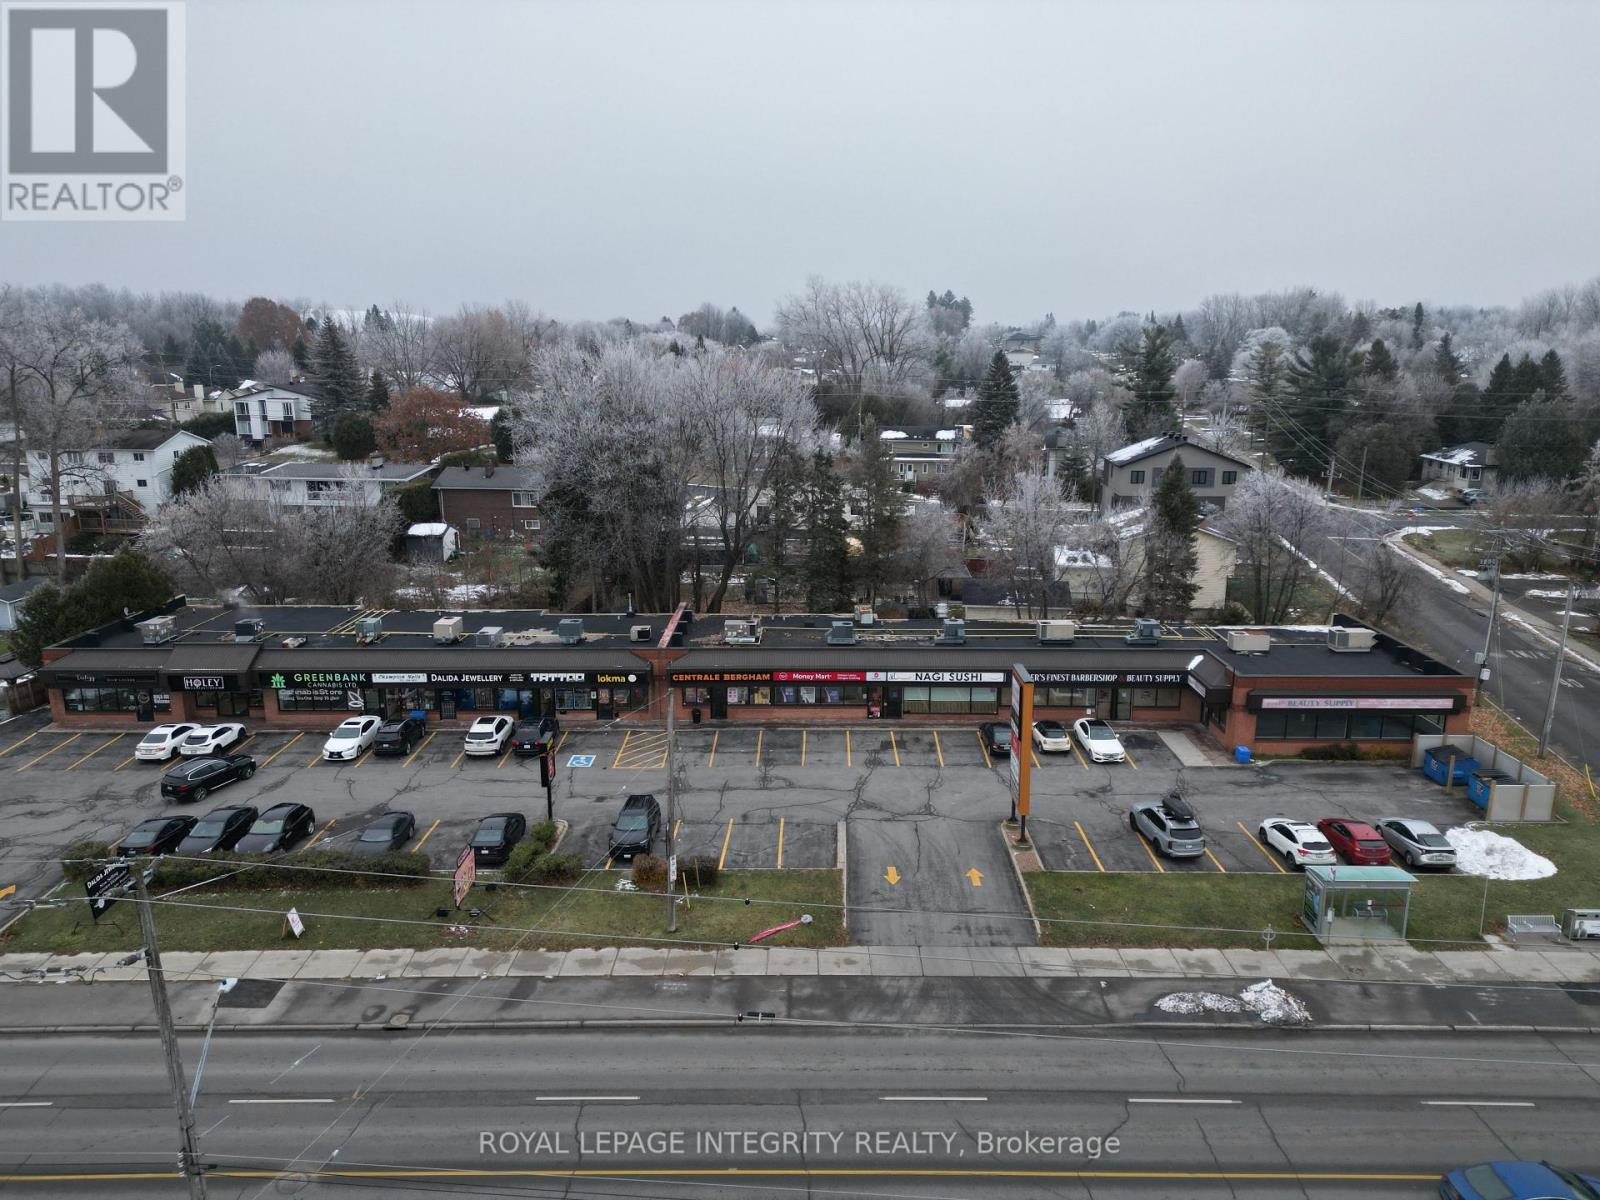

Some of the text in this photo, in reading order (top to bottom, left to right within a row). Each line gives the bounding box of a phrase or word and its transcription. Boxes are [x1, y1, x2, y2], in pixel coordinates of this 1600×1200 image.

[293, 673, 366, 682] GREENBANK
[431, 674, 459, 682] DALIDA
[461, 674, 502, 682] JEWELLERY
[530, 673, 585, 682] TATTOO
[597, 674, 626, 683] lokma
[792, 673, 813, 681] Money
[915, 672, 982, 681] NAGI SUSHI
[1047, 674, 1069, 682] FINEST
[1071, 674, 1118, 682] BARBERSHOP
[1126, 674, 1153, 682] BEAUTY
[1155, 674, 1182, 682] SUPPLY
[186, 679, 220, 688] HOLEY
